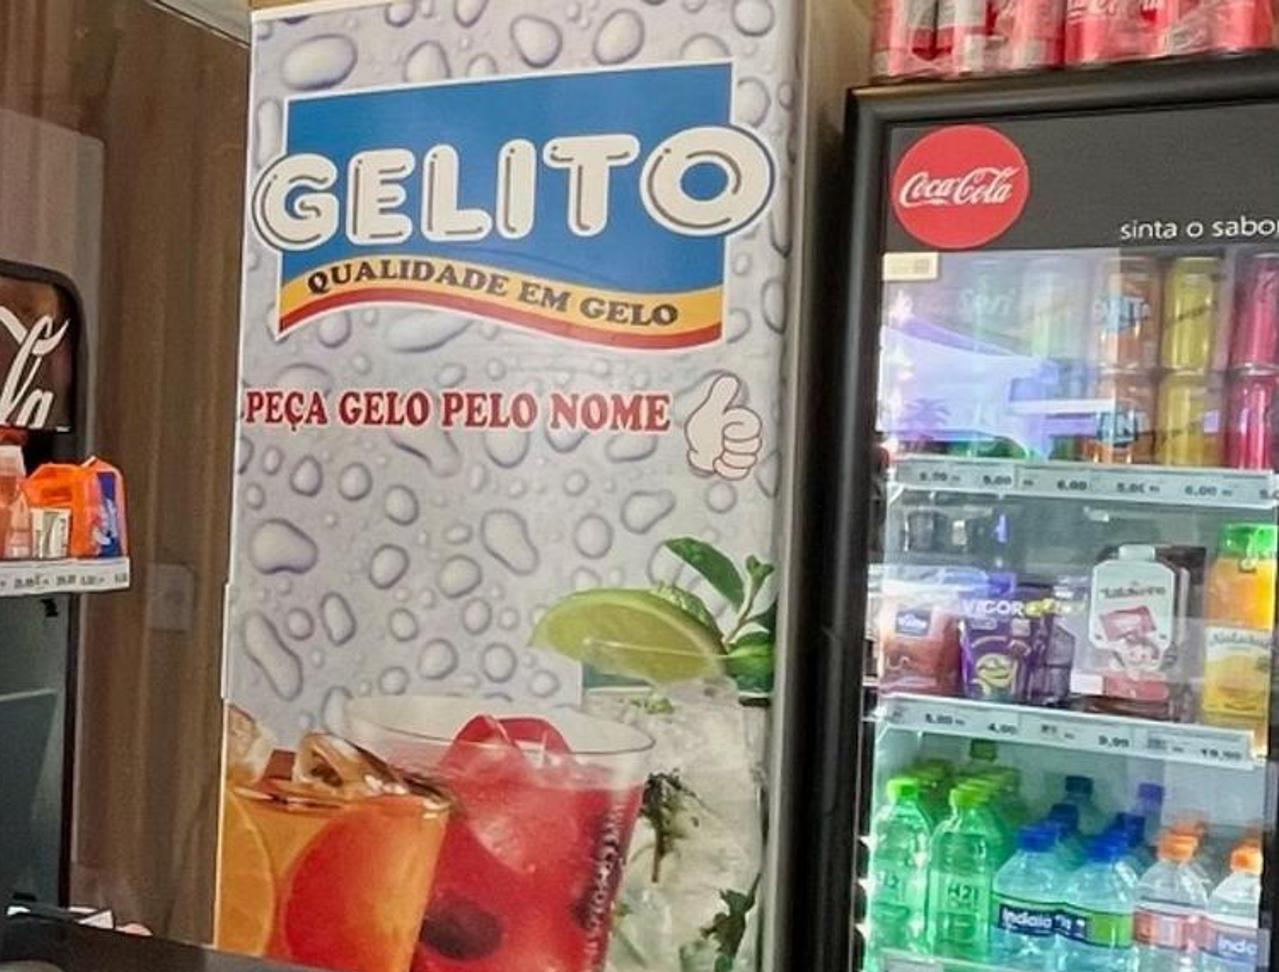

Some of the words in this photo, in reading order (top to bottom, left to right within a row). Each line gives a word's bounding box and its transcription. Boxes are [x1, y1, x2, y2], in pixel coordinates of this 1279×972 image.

[252, 125, 775, 250] GELITO
[899, 166, 1020, 207] Coca-Cola
[1120, 220, 1177, 240] sinta
[1188, 222, 1204, 238] o
[307, 257, 507, 297] QUALIDADE
[519, 282, 570, 313] EM
[579, 297, 679, 327] GELO
[245, 389, 328, 432] PEÇA
[339, 390, 430, 427] GELO
[441, 392, 538, 429] PELO
[551, 393, 671, 433] NOME
